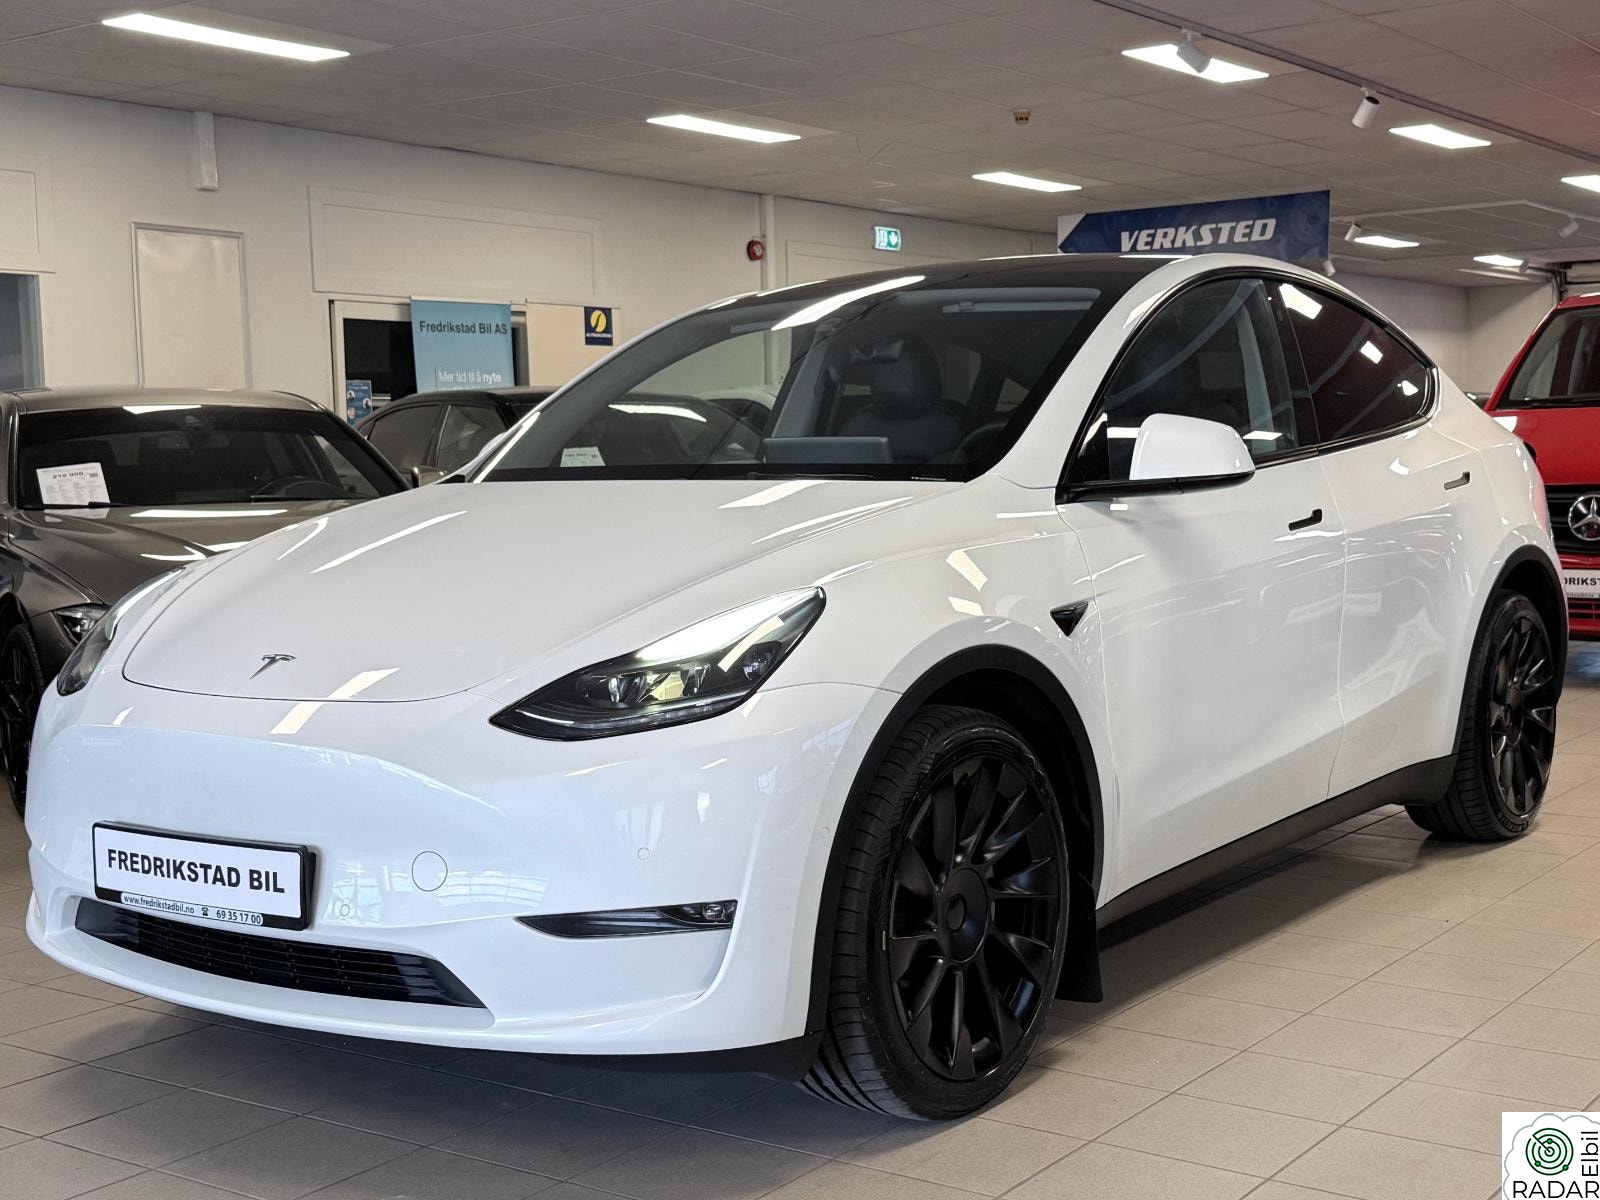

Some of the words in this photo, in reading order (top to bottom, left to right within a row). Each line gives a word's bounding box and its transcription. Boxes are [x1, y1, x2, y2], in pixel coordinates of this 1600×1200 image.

[1120, 218, 1277, 252] VERKSTED
[419, 320, 477, 334] Fredrikstad
[479, 322, 492, 335] Bil
[494, 323, 508, 335] AS
[438, 370, 454, 383] Mer
[456, 370, 467, 383] tid
[482, 372, 502, 385] nyte
[107, 848, 241, 888] FREDRIKSTAD
[249, 868, 285, 894] BIL
[123, 894, 195, 914] www.fredrikstadbil.no
[216, 909, 227, 920] 69
[227, 911, 238, 921] 35
[240, 912, 249, 923] 17
[250, 914, 262, 925] 00
